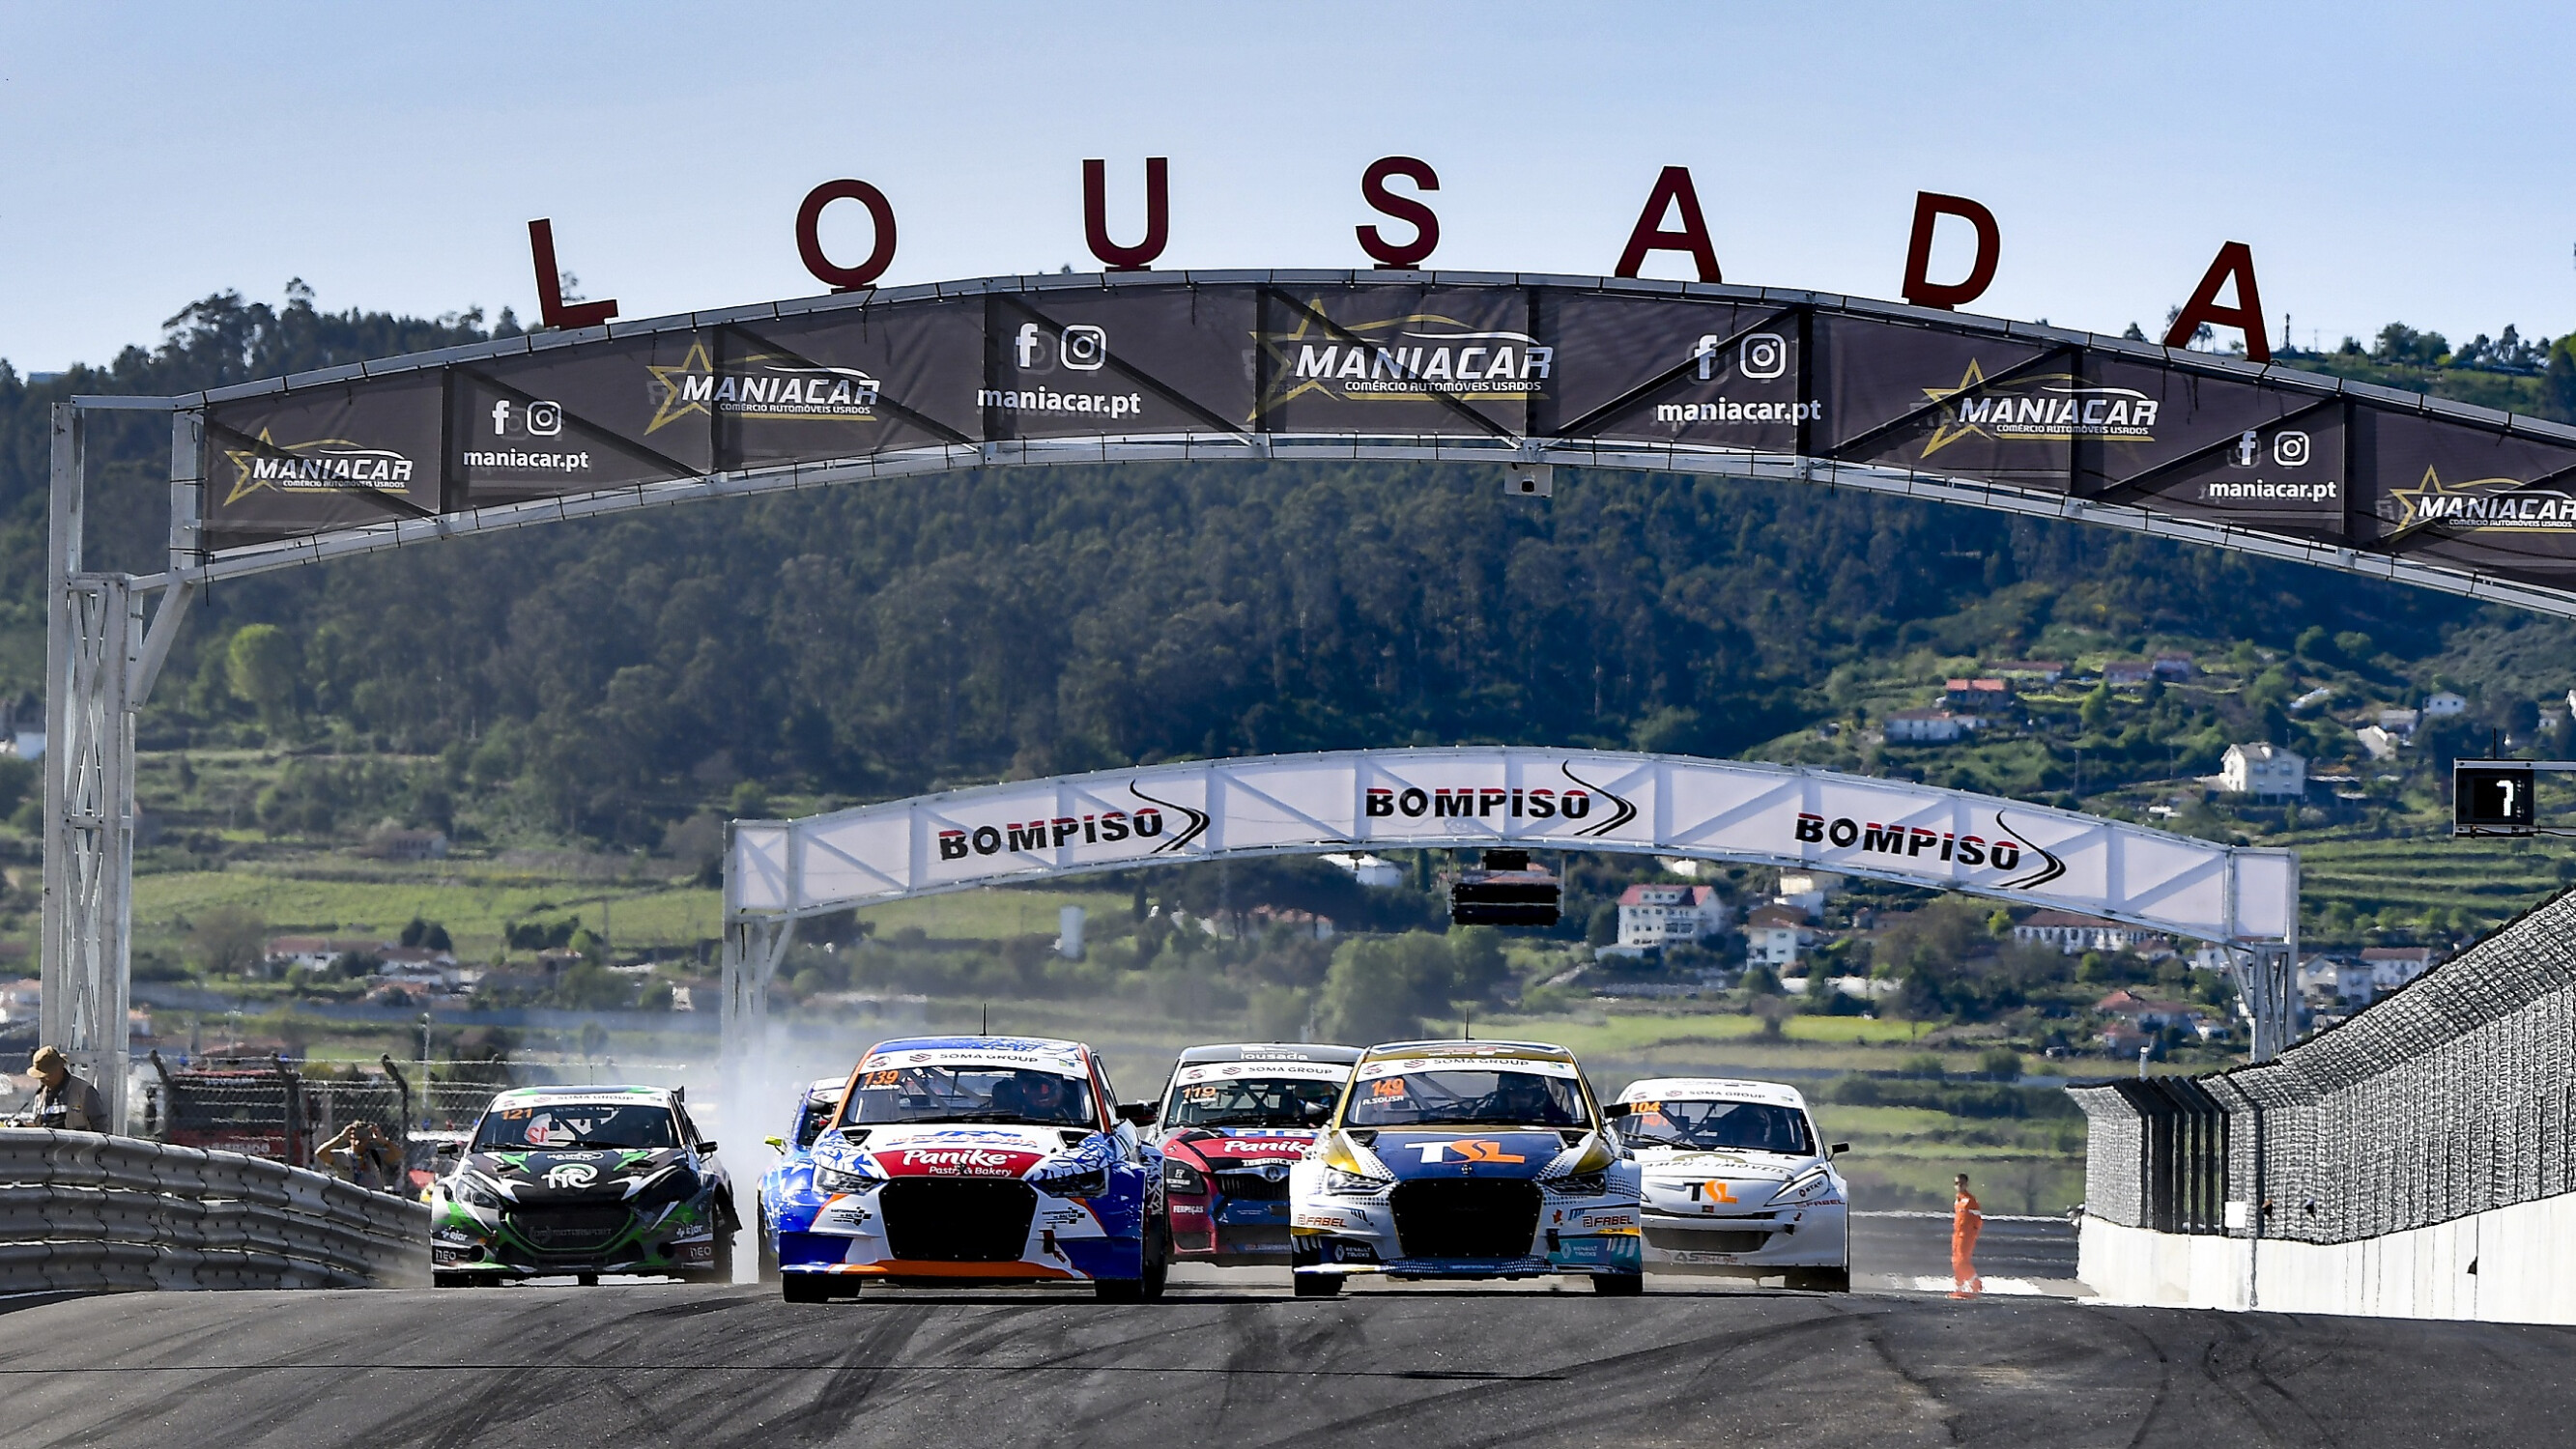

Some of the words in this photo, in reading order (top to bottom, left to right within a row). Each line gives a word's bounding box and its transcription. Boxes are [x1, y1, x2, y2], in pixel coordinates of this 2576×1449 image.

[1295, 344, 1555, 381] MANIACAR
[682, 375, 881, 406] MANIACAR
[1492, 382, 1542, 391] USADOS
[977, 385, 1141, 419] maniacar.pt
[1657, 396, 1821, 426] maniacar.pt
[1959, 397, 2160, 426] MANIACAR
[252, 458, 414, 481] MANIACAR
[463, 447, 589, 472] maniacar.pt
[2208, 479, 2337, 503] maniacar.pt
[2419, 496, 2576, 521] MANIACAR
[1365, 787, 1590, 820] BOMPISO
[2496, 780, 2514, 817] 7
[938, 808, 1163, 862] BOMPISO
[1794, 812, 2020, 871] BOMPISO
[987, 1054, 1039, 1064] GROUP
[1240, 1051, 1308, 1061] lousada
[864, 1070, 900, 1086] 139
[1371, 1078, 1406, 1097] 149
[1182, 1086, 1216, 1099] 119
[501, 1108, 533, 1121] 121
[1629, 1101, 1661, 1114] 104
[902, 1149, 1009, 1167] Panike
[1404, 1139, 1527, 1165] TSL
[975, 1167, 1013, 1178] Bakery
[1683, 1179, 1738, 1205] TSL
[1305, 1217, 1348, 1228] FABEL
[1594, 1215, 1634, 1227] FABEL
